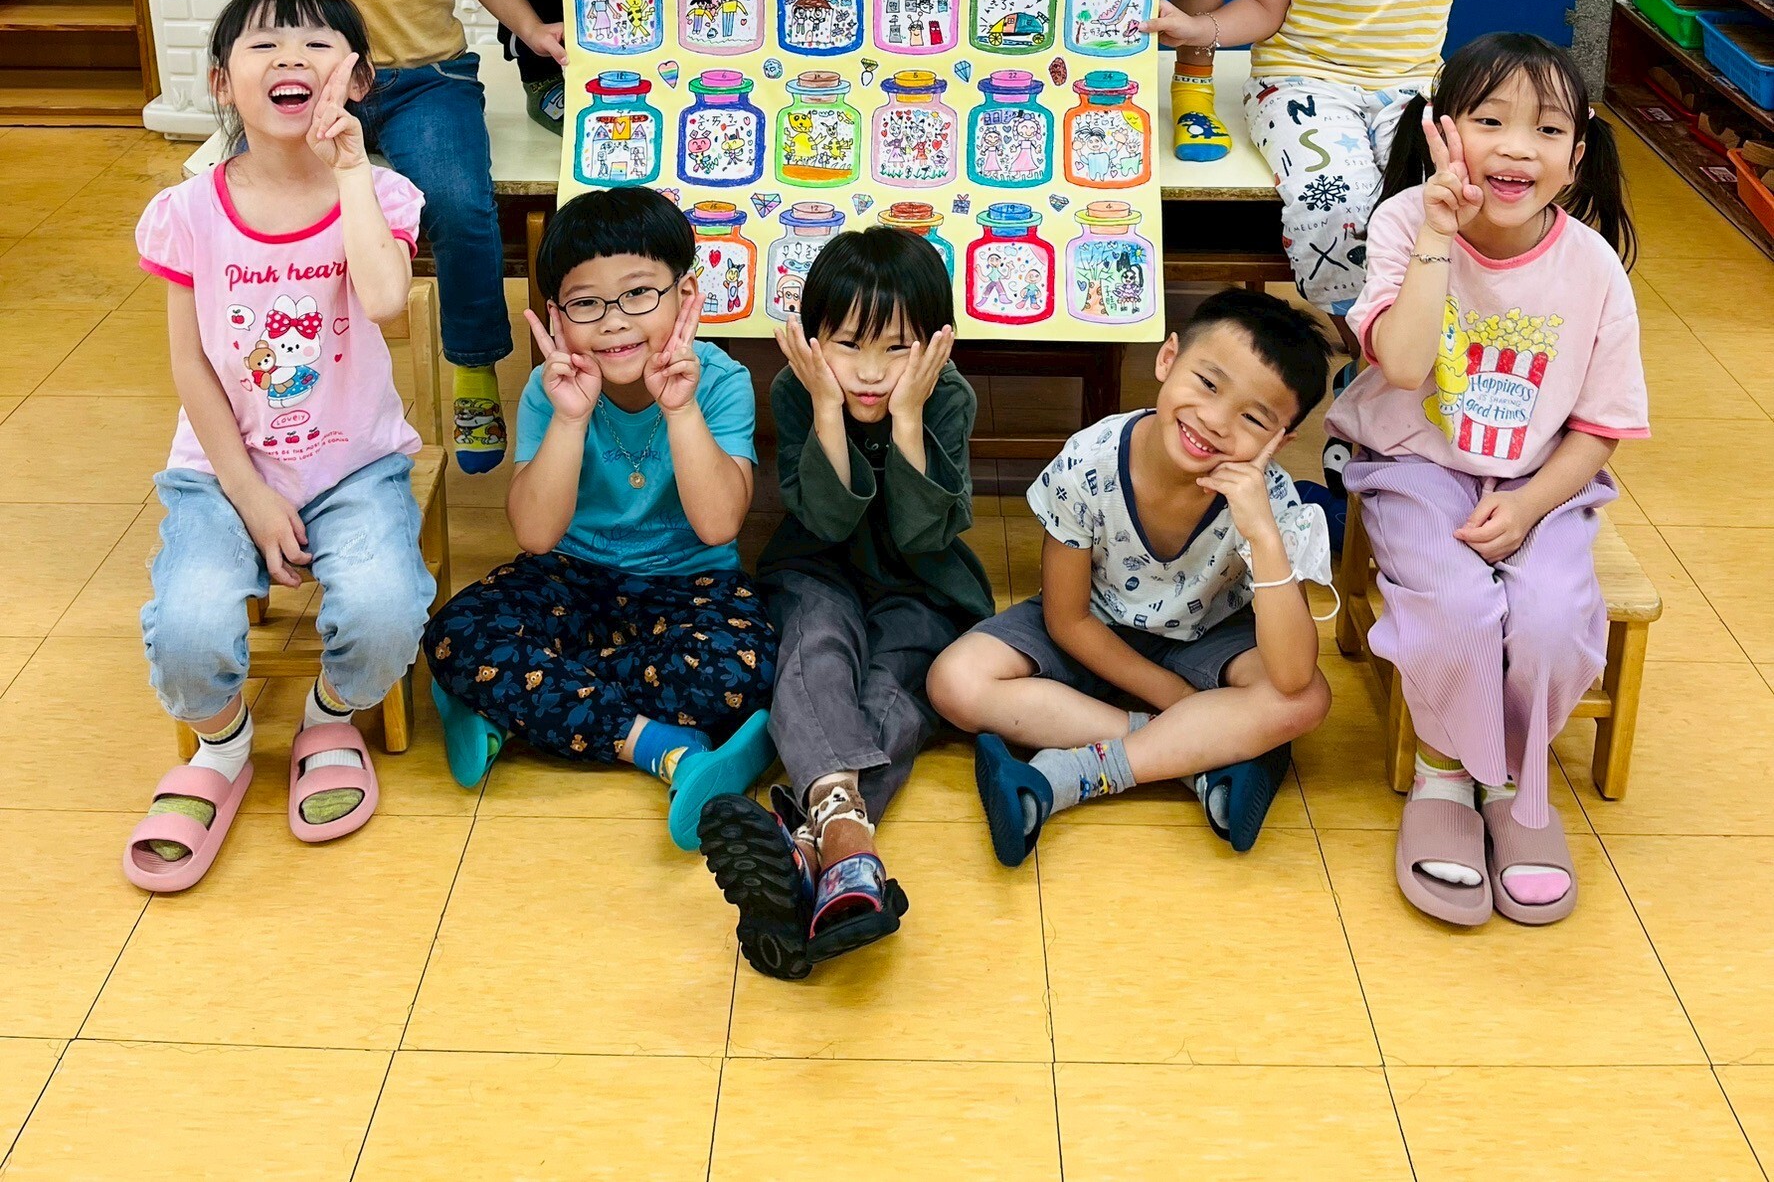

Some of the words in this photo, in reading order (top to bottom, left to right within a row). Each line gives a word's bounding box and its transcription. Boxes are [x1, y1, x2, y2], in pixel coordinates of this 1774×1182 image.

[1299, 128, 1332, 173] S
[1308, 236, 1350, 281] X
[225, 263, 280, 291] Pink
[1470, 374, 1535, 402] Happiness
[1466, 398, 1491, 418] good
